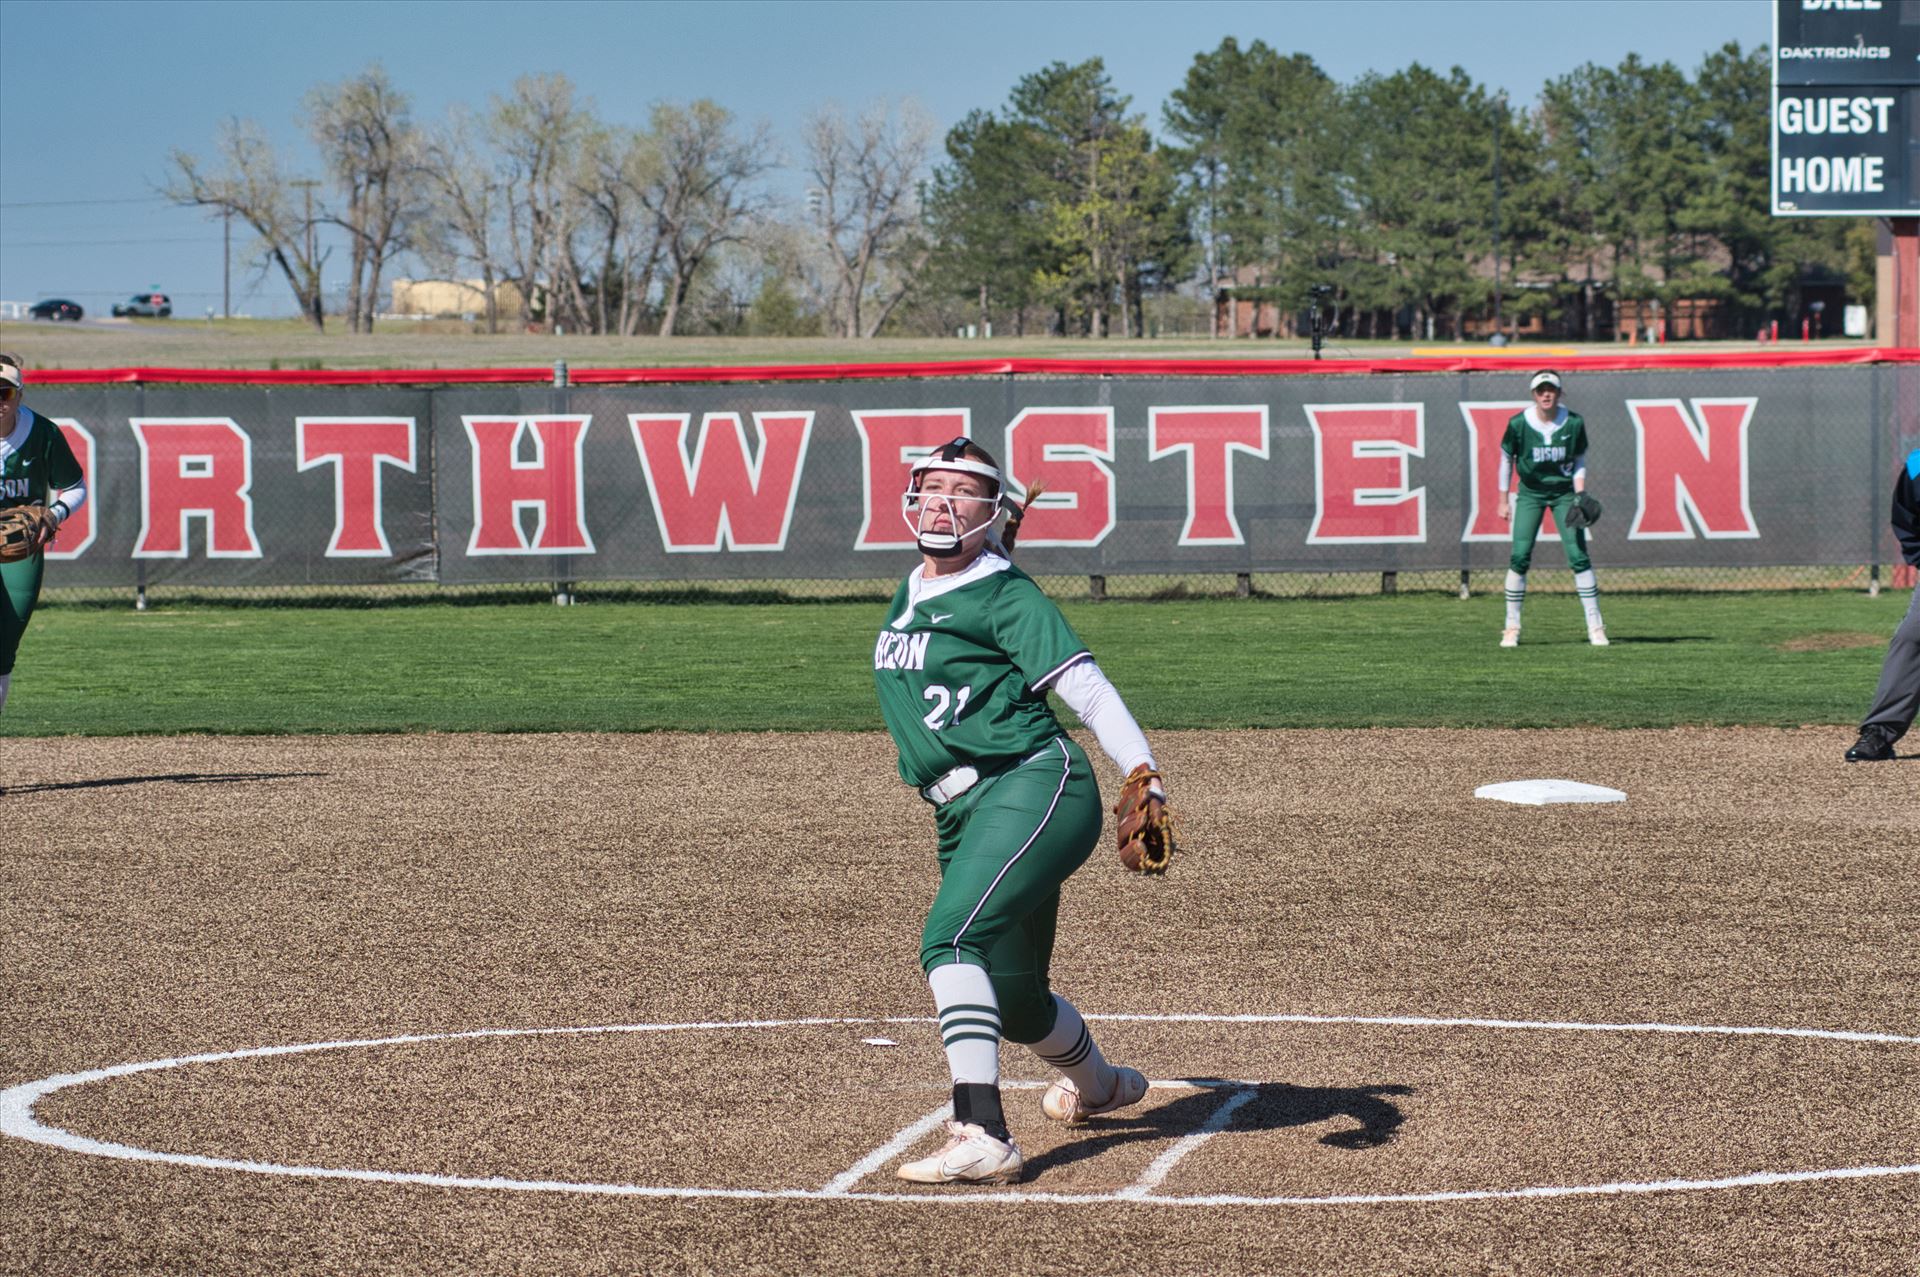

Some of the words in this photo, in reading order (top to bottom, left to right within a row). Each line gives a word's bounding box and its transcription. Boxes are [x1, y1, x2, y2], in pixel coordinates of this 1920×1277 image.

[1780, 47, 1890, 58] DAKTRONICS
[1779, 97, 1894, 134] GUEST
[1782, 156, 1884, 193] HOME
[1533, 446, 1566, 462] BISON
[923, 685, 970, 730] 21
